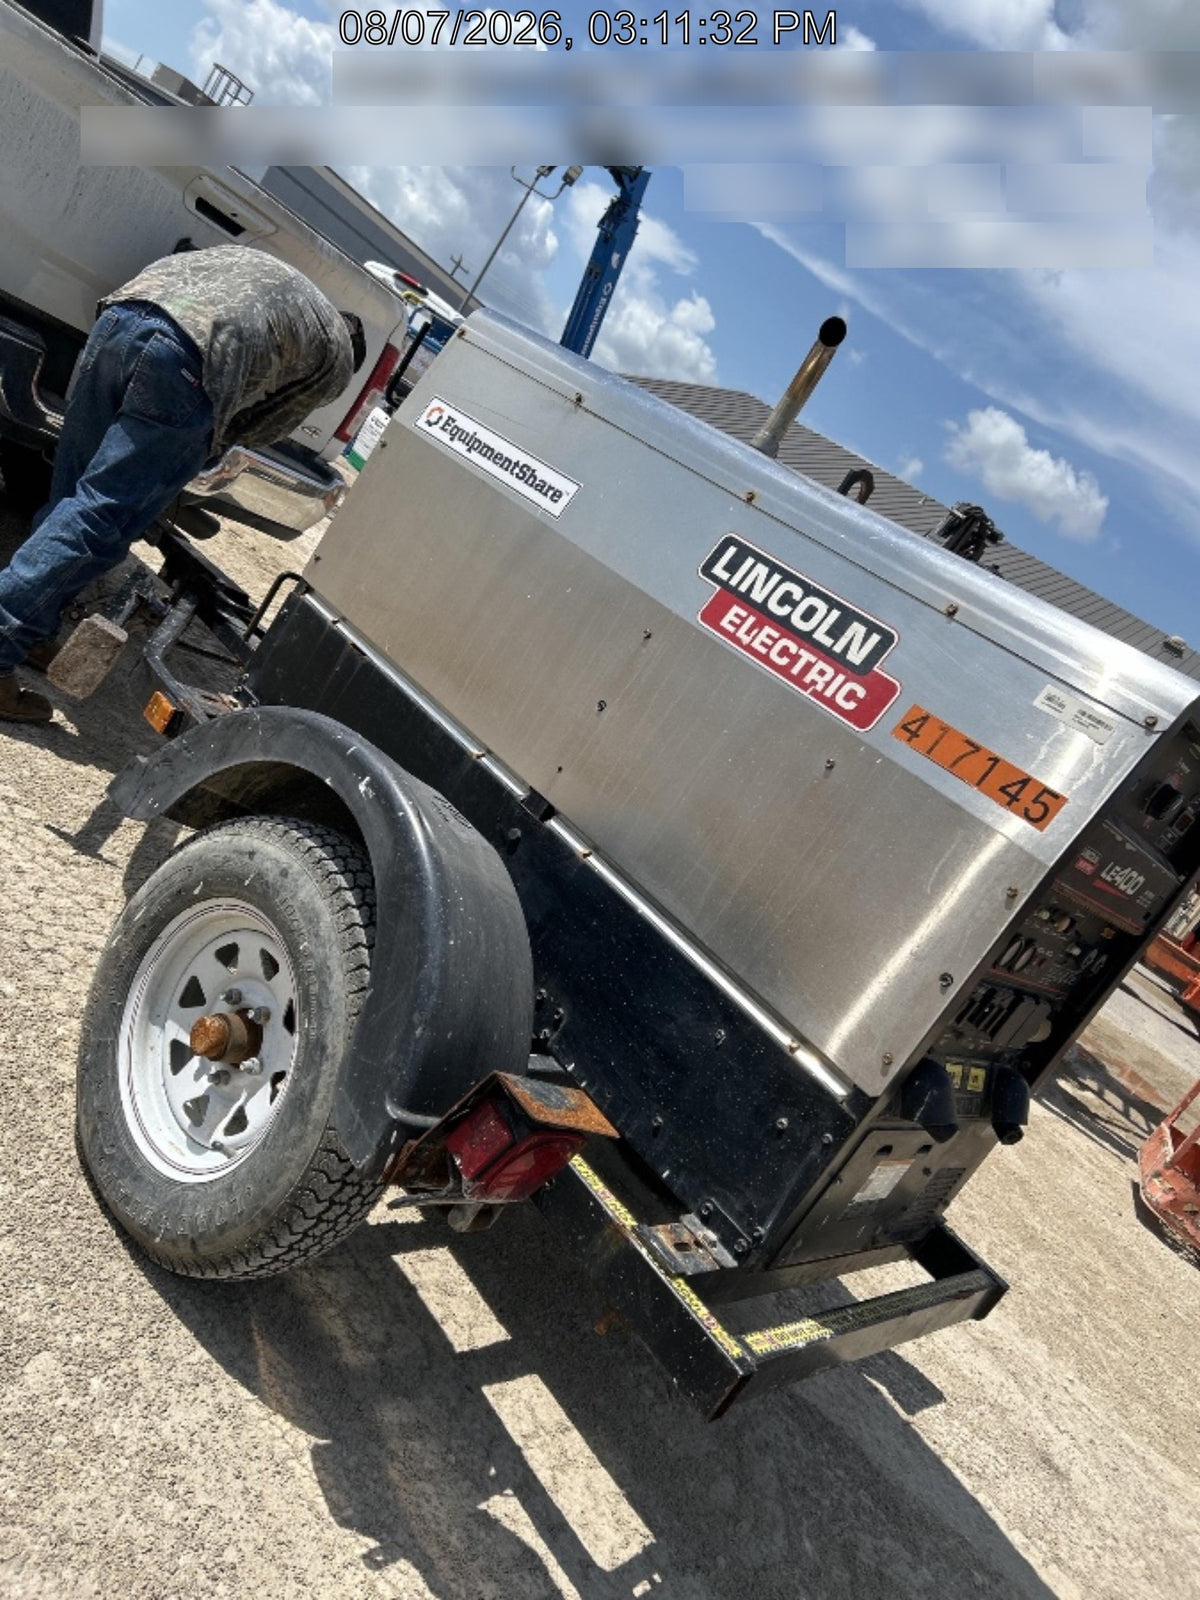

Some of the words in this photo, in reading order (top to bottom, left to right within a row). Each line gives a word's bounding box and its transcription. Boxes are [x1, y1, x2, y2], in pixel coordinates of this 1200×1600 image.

[440, 416, 563, 504] EquipmentShare
[711, 545, 882, 666] LINCOLN
[719, 604, 867, 711] ELECTRIC
[900, 713, 1060, 824] 417145
